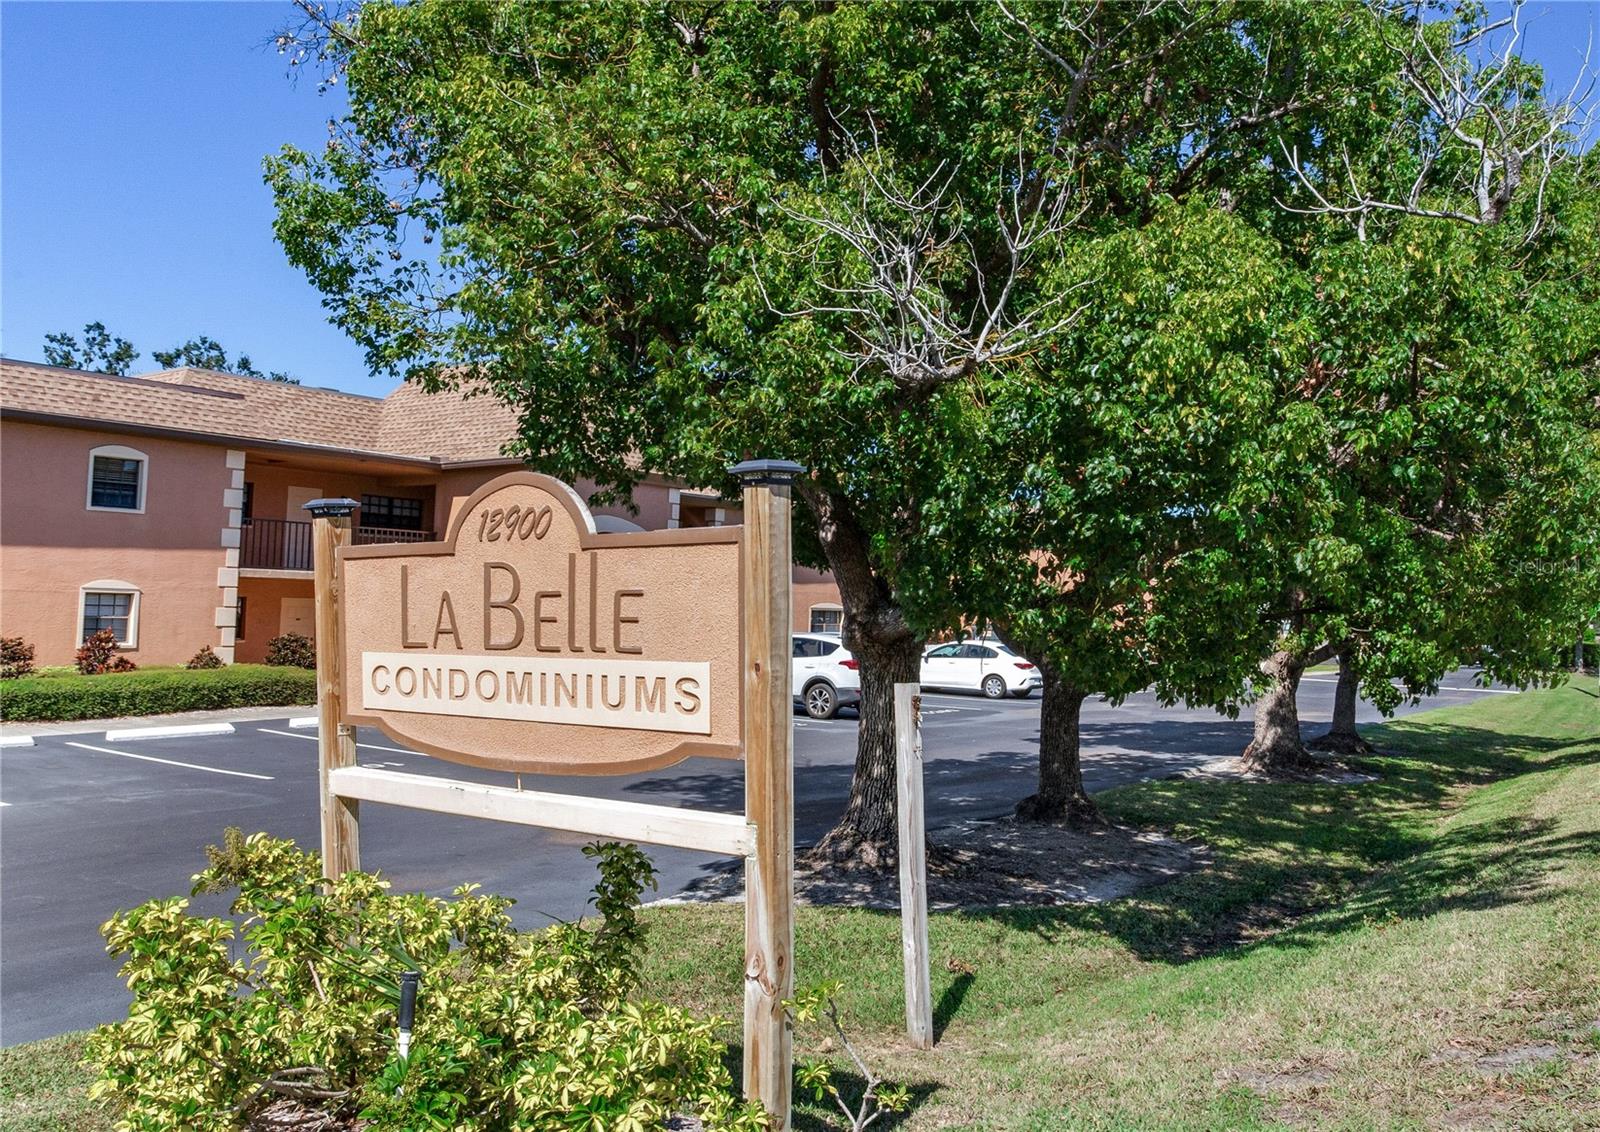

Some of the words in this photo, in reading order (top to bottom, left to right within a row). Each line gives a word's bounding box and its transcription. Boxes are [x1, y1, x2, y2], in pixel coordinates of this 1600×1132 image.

[478, 504, 552, 542] 12900
[401, 565, 463, 650] LA
[371, 664, 701, 714] CONDOMINIUMS
